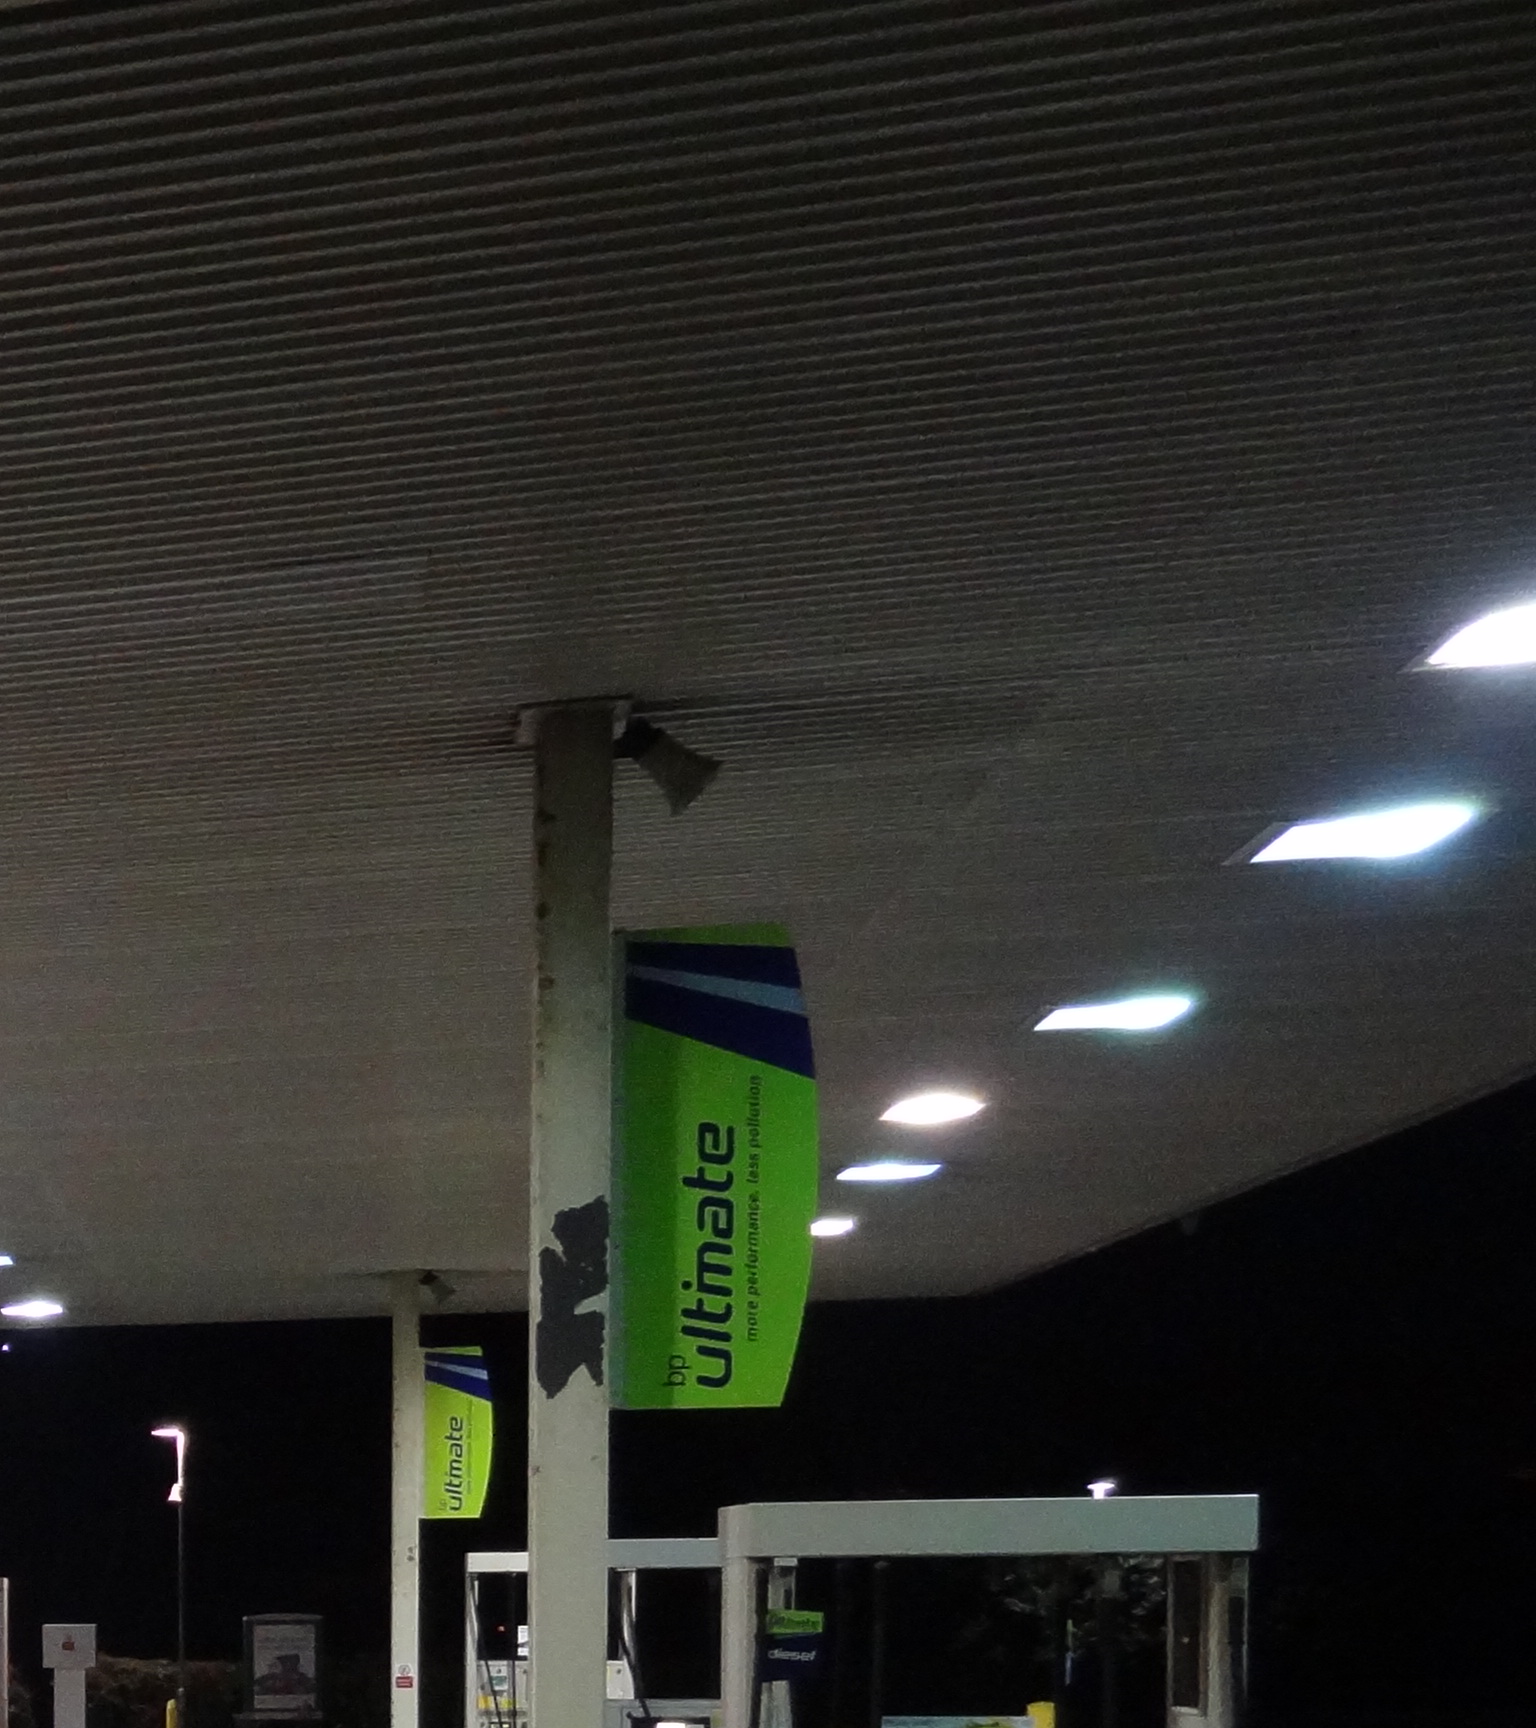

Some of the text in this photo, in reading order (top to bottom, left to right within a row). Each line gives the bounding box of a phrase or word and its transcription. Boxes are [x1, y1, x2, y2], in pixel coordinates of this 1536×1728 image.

[681, 1121, 733, 1388] ultimate
[663, 1354, 691, 1387] bp
[444, 1416, 463, 1512] ultimate
[767, 1647, 817, 1661] diesel
